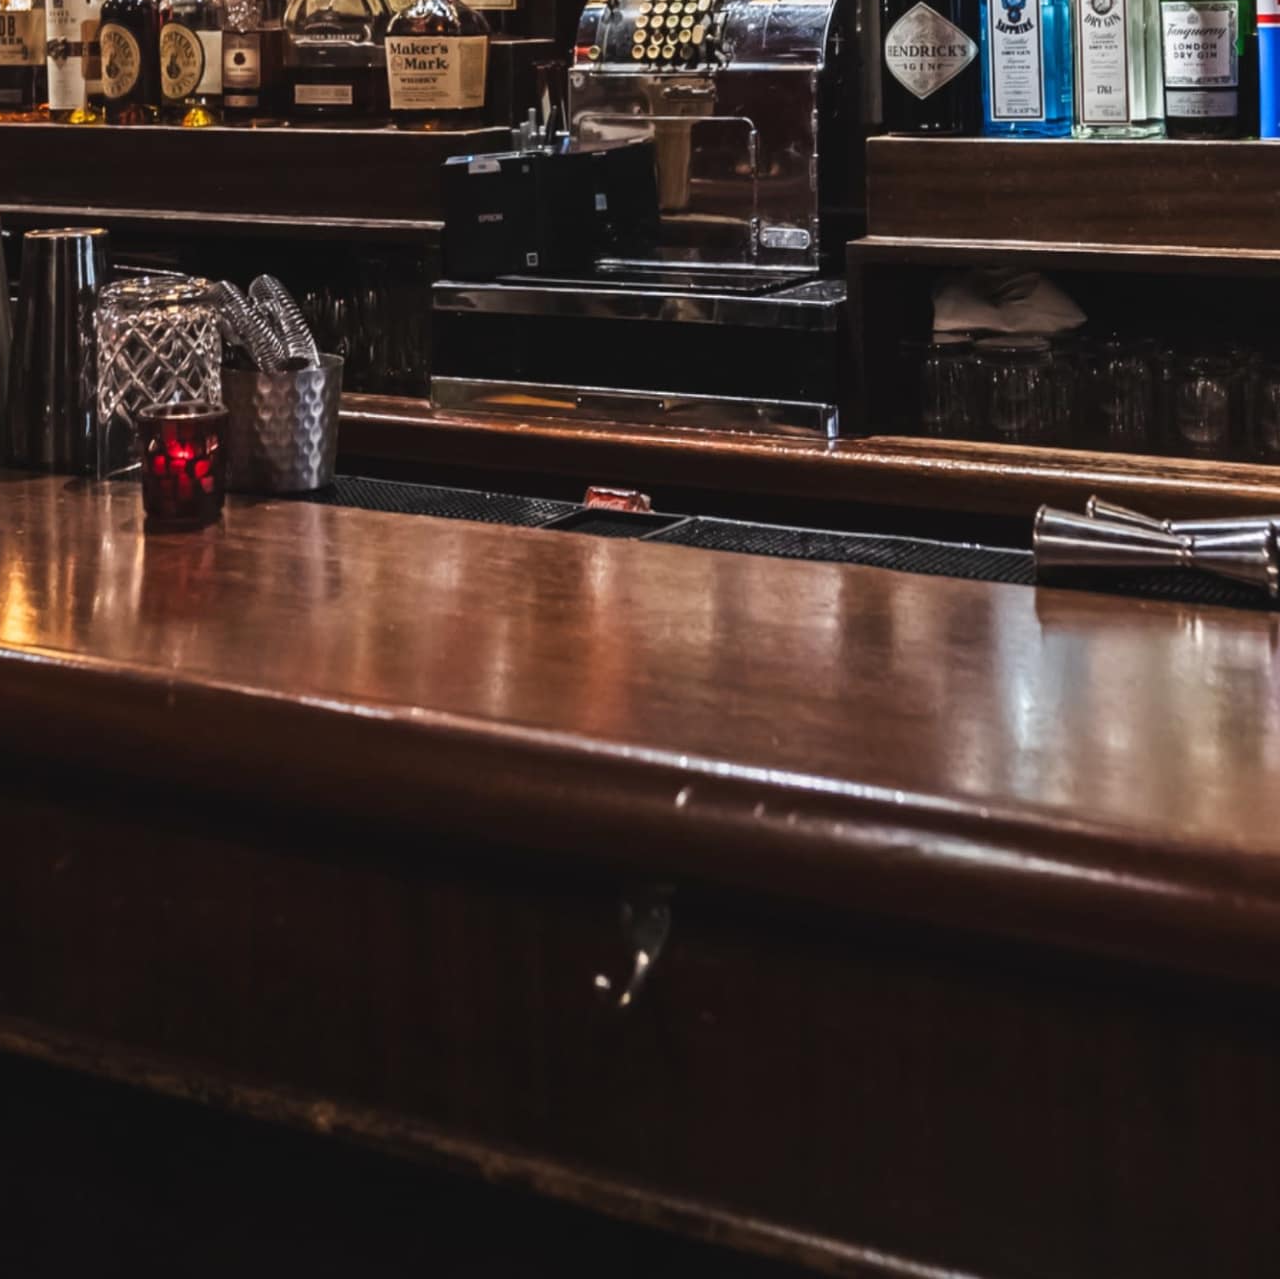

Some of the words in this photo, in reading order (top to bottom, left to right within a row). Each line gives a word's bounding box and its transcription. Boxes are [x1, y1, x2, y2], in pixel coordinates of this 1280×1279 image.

[994, 18, 1035, 36] SAPPHIRE
[1083, 13, 1104, 28] DRY
[1105, 13, 1122, 29] GIN
[1166, 23, 1228, 40] Tanqueray
[389, 41, 450, 56] Maker's
[887, 43, 968, 58] HENDRICK'S
[1173, 43, 1218, 52] LONDON
[404, 56, 449, 70] Mark
[1173, 51, 1195, 60] DRY
[1197, 51, 1218, 60] GIN
